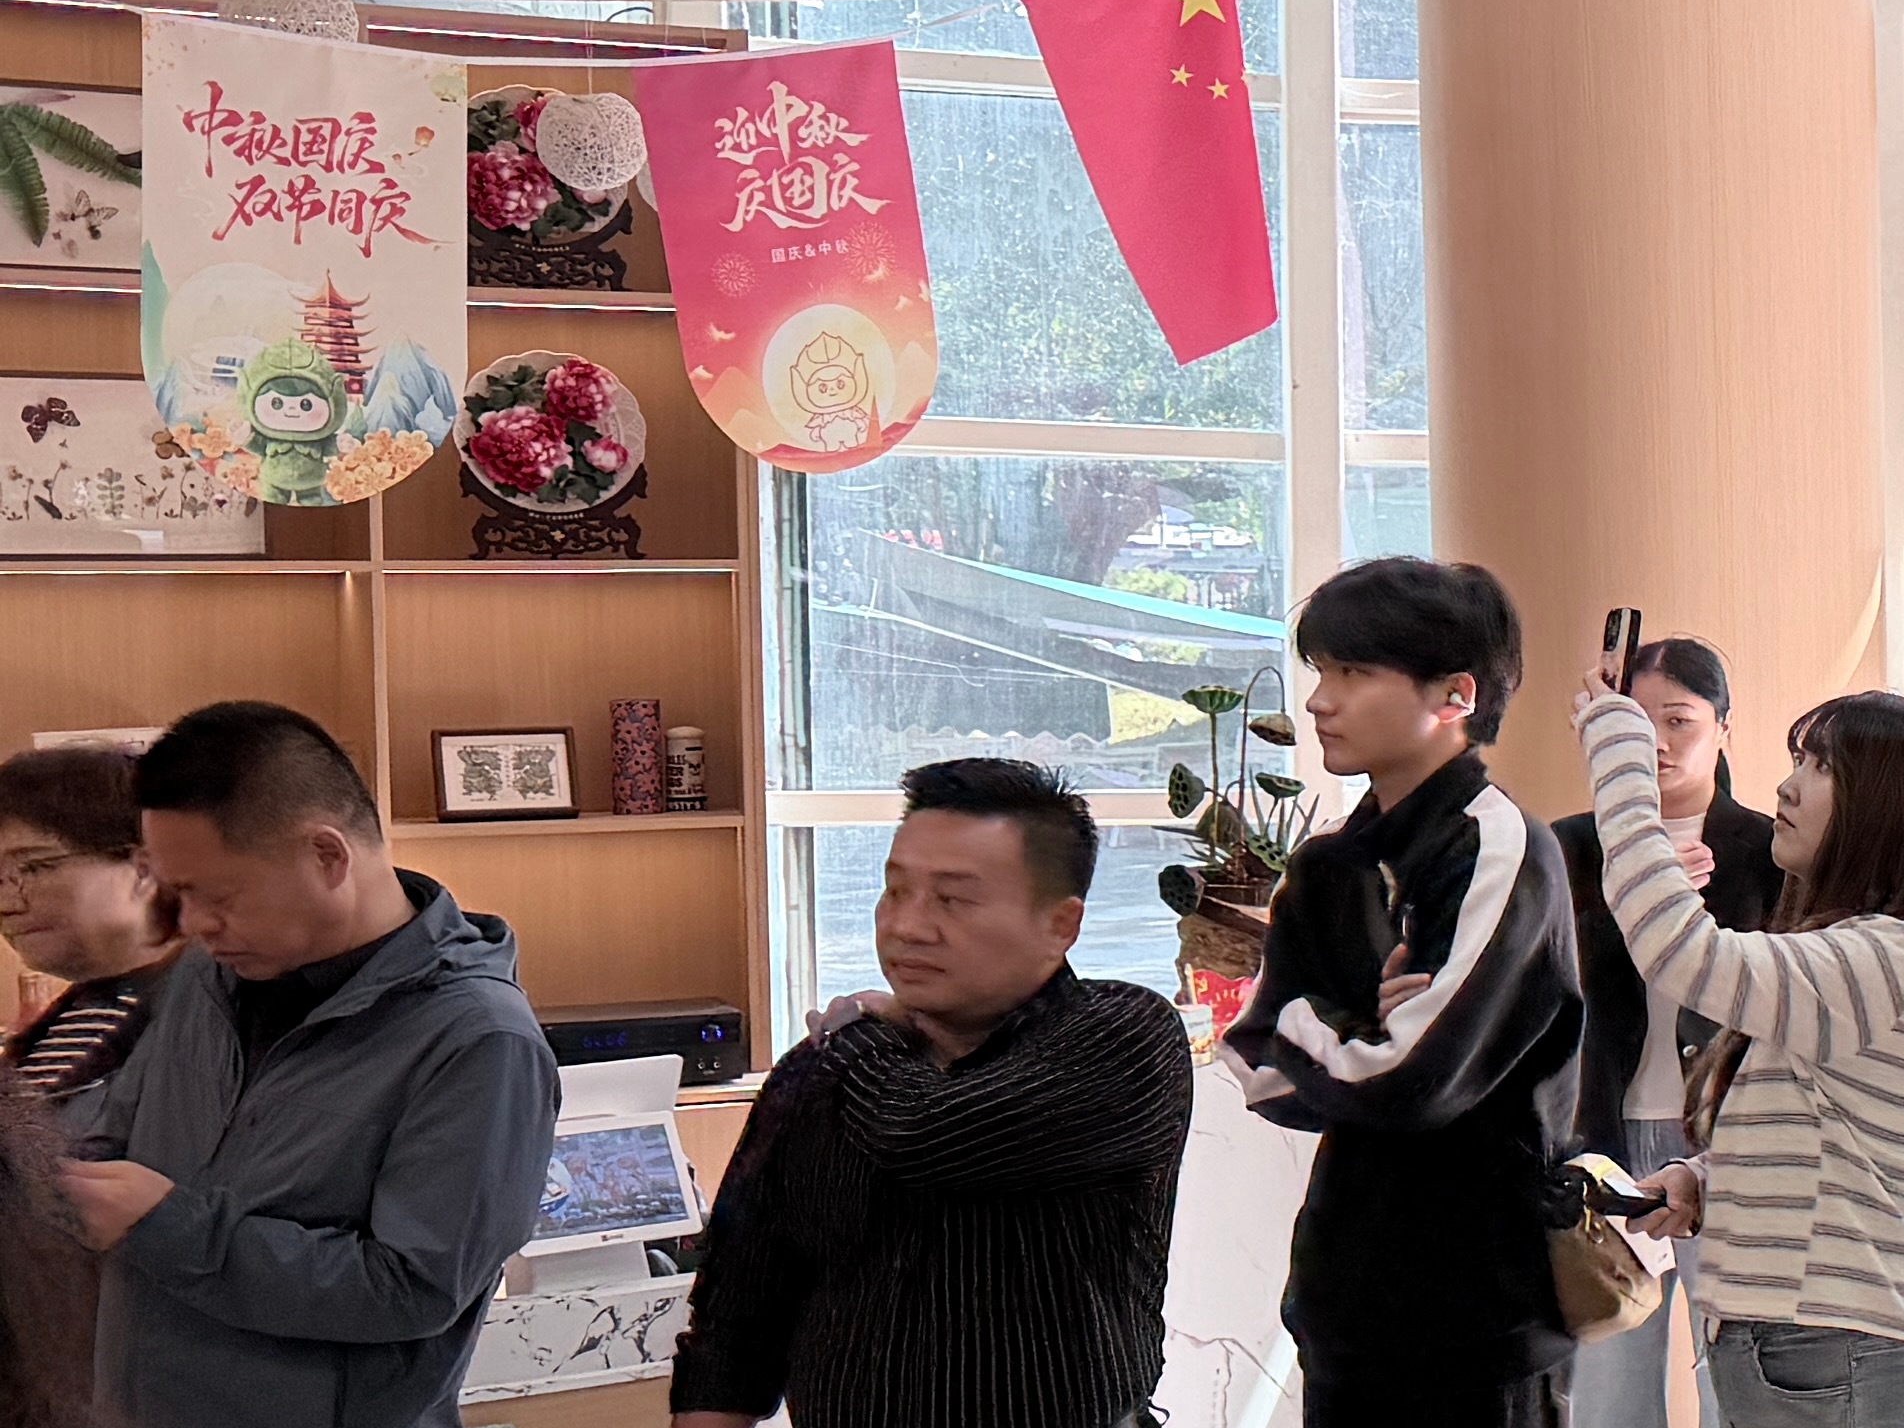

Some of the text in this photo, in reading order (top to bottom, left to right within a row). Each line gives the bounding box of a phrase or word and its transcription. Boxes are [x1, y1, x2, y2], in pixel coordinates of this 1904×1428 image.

[182, 80, 386, 178] 中秋国庆
[714, 80, 872, 166] 迎中秋
[211, 174, 456, 259] 双节同庆
